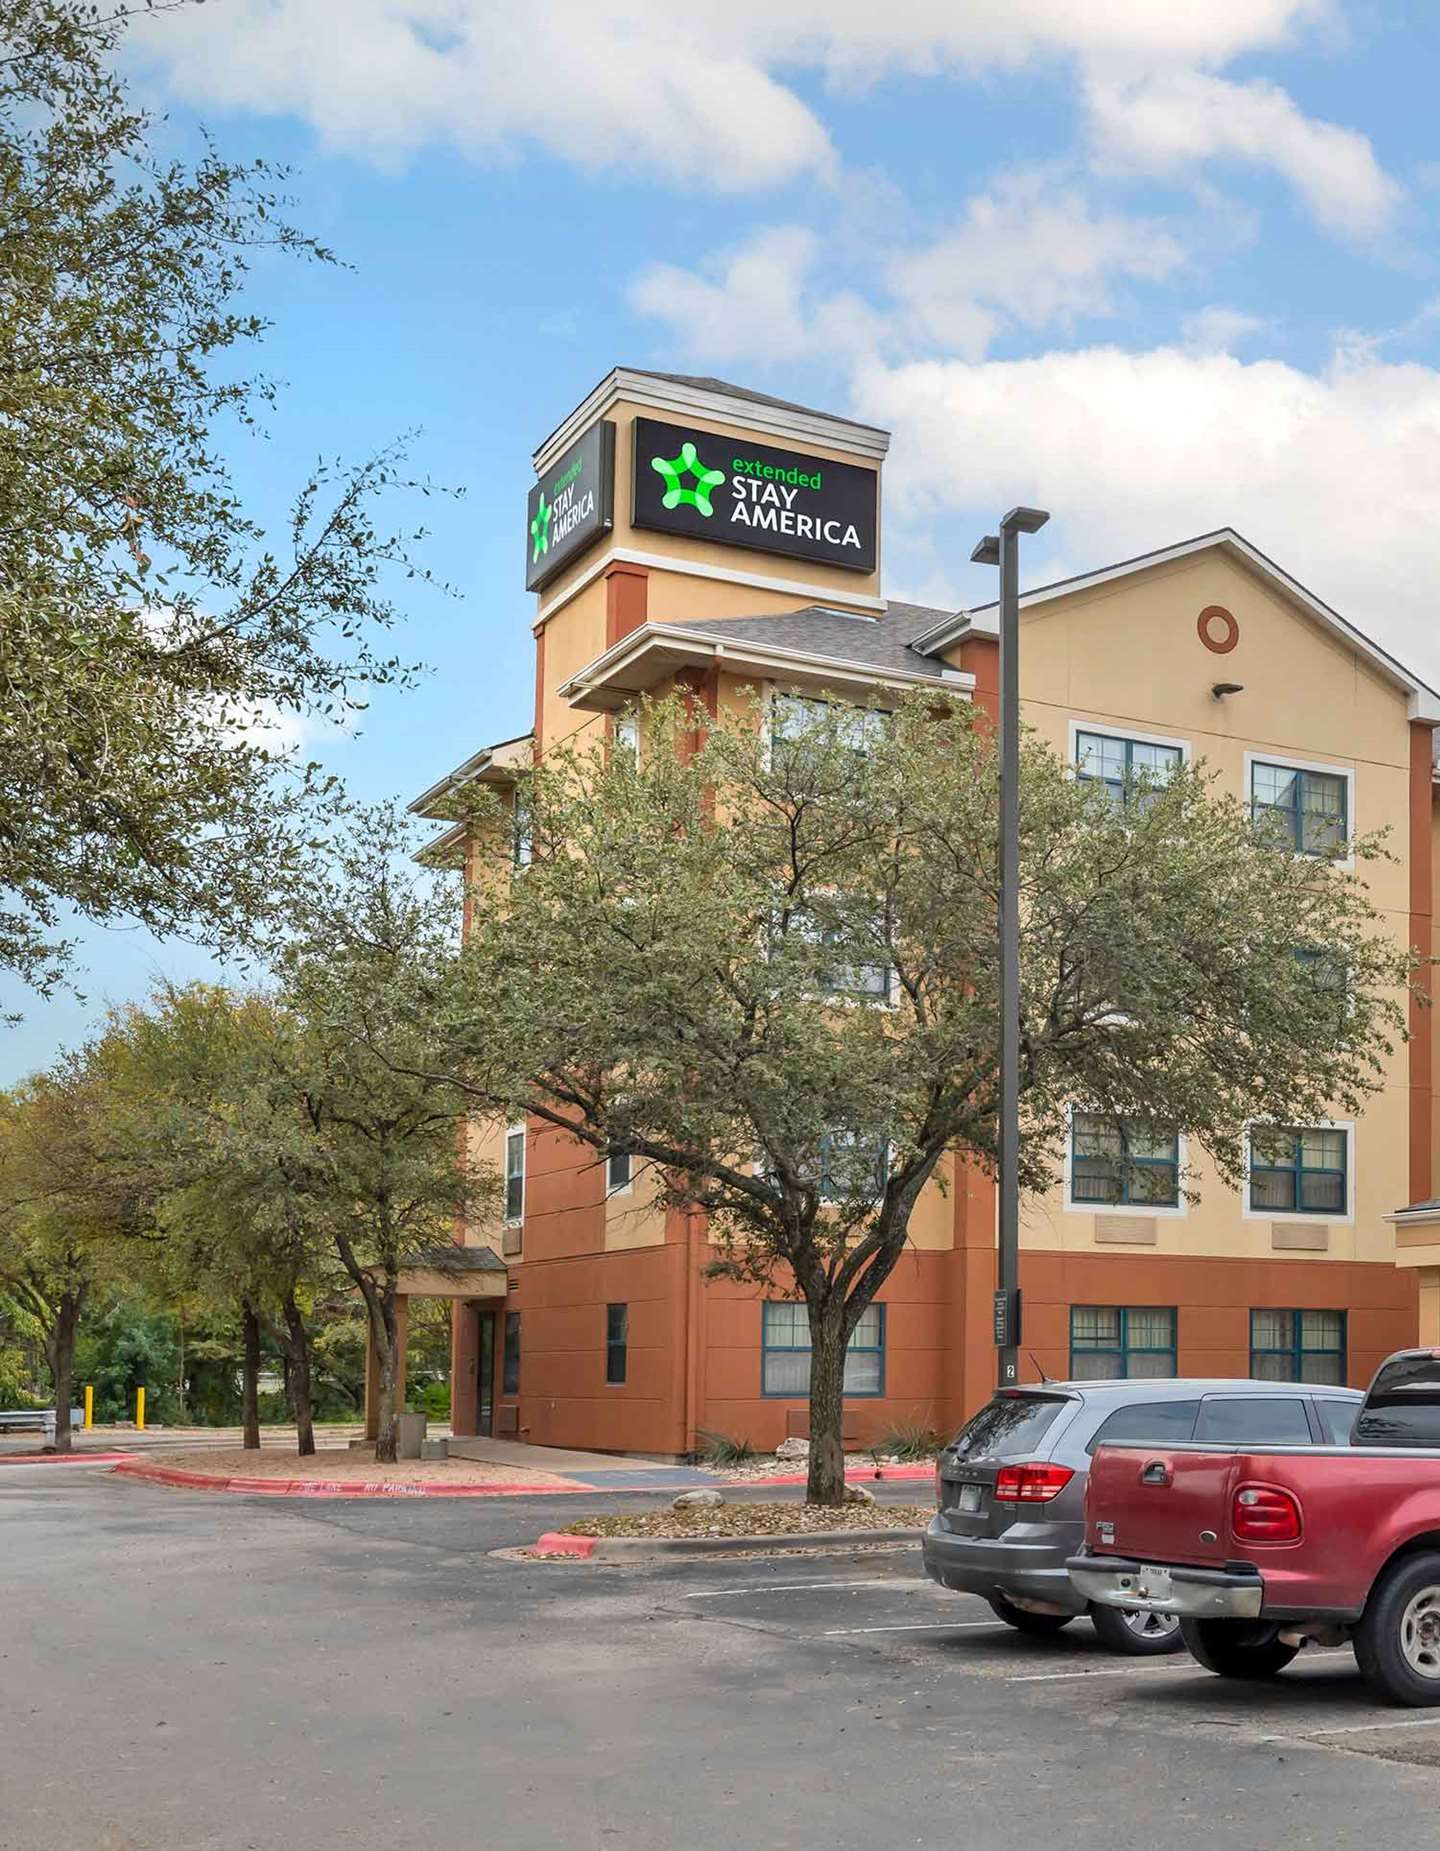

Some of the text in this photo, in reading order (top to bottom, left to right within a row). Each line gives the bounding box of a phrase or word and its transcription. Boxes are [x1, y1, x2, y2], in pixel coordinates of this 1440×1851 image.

[731, 475, 799, 510] STAY
[732, 458, 822, 490] extended
[552, 482, 575, 522] STAY
[552, 490, 594, 547] AMERICA
[730, 500, 862, 549] AMERICA
[1007, 1366, 1015, 1377] 2
